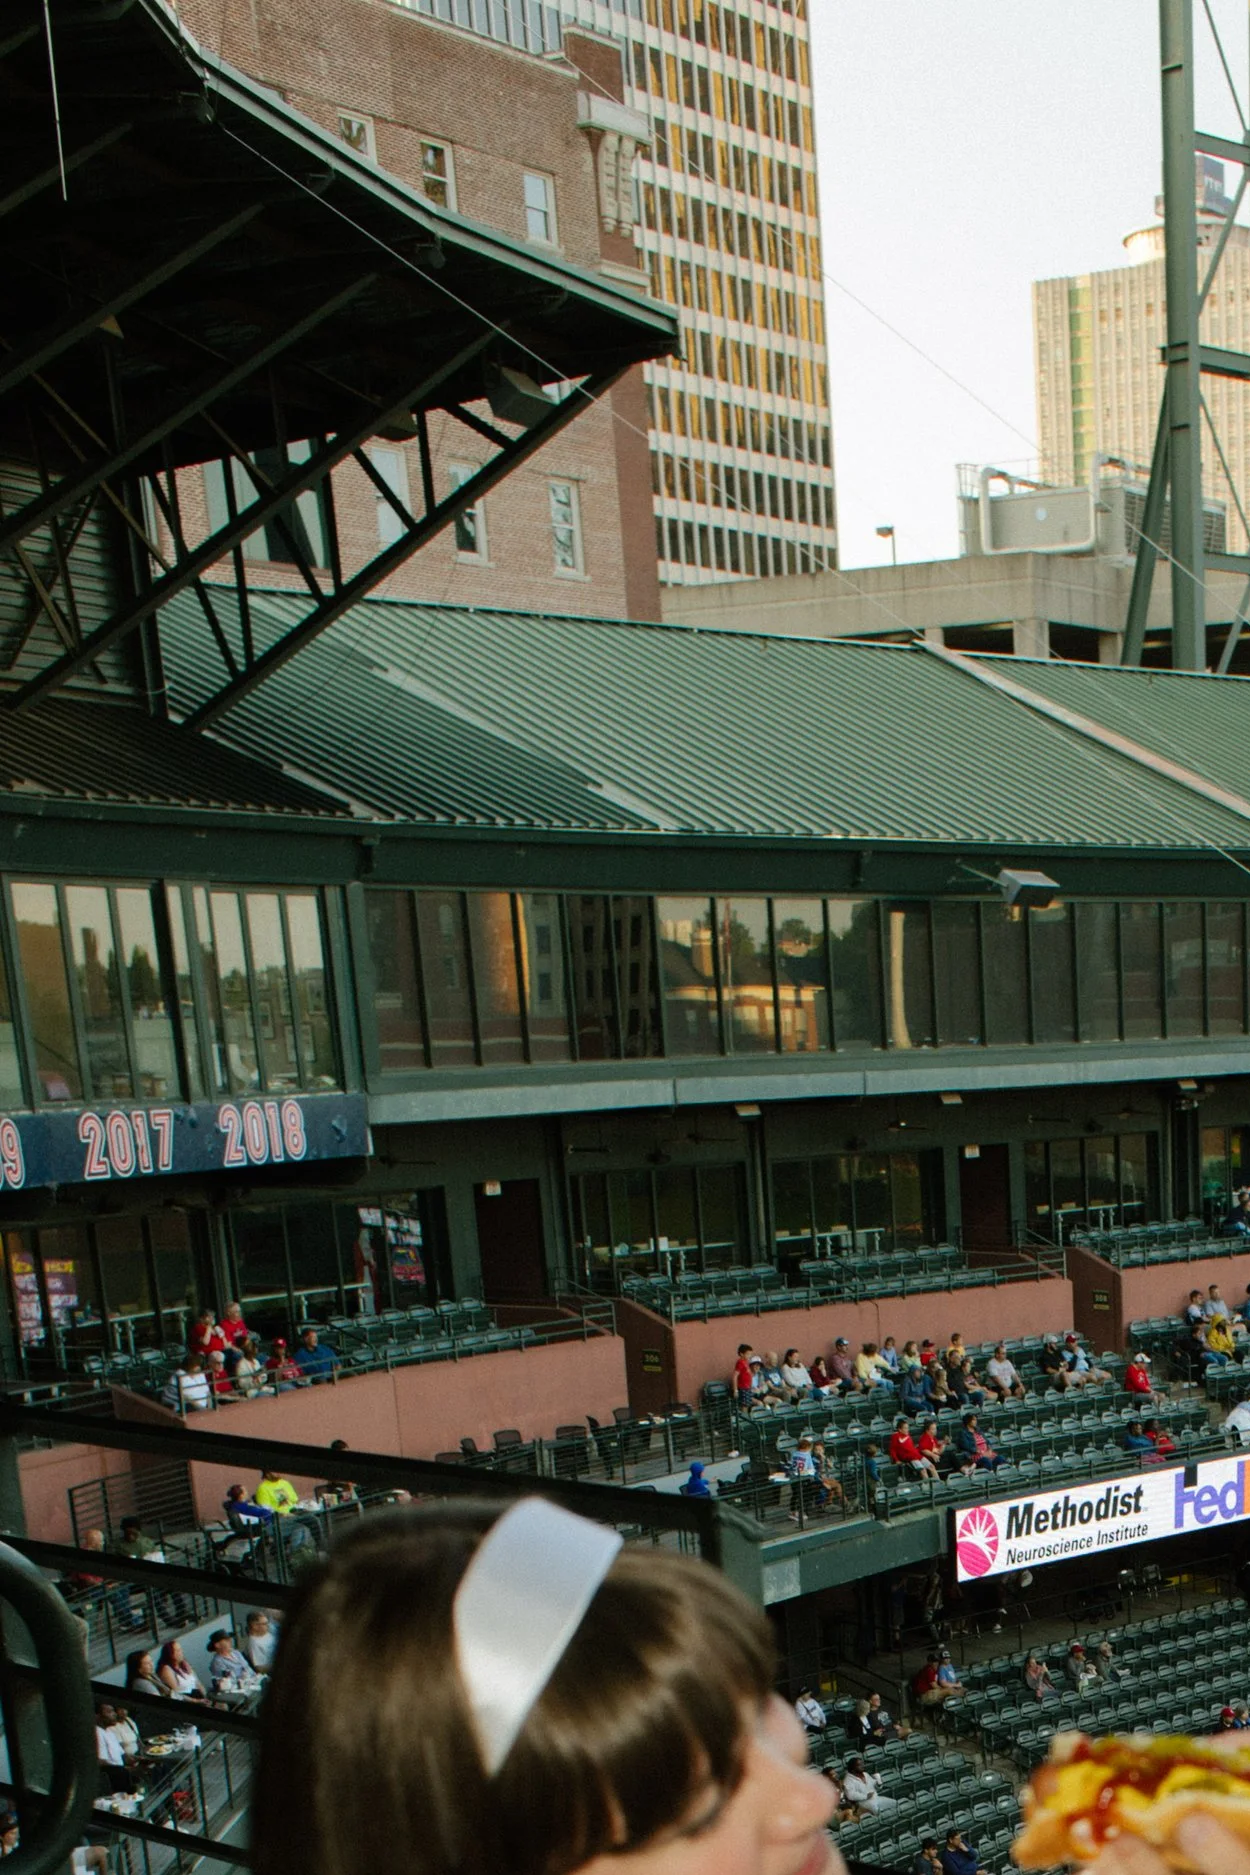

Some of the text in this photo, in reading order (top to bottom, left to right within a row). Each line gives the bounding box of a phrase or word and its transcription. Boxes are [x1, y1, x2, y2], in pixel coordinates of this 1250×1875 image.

[79, 1109, 173, 1181] 2017
[219, 1100, 306, 1167] 2018
[1006, 1484, 1144, 1540] Methodist
[1006, 1522, 1149, 1566] Neuroscience Institute
